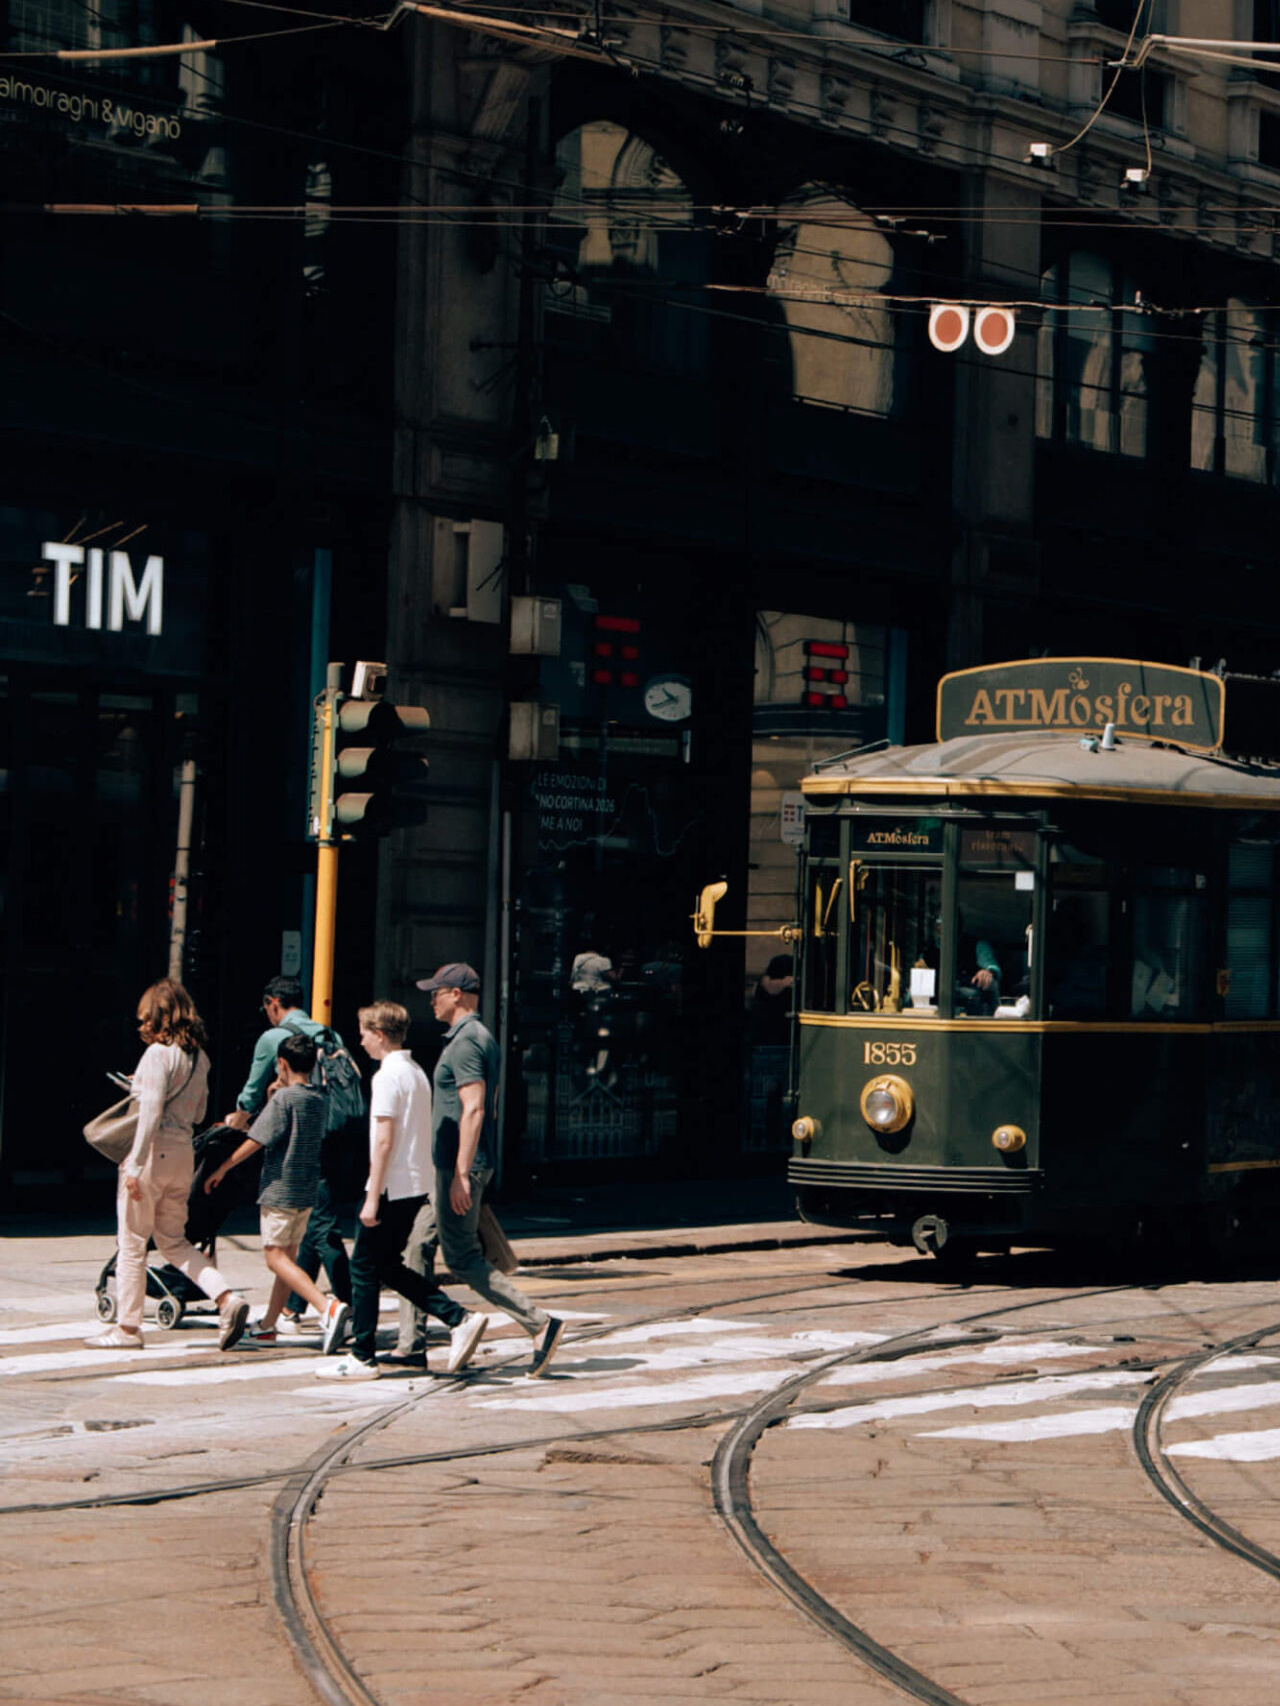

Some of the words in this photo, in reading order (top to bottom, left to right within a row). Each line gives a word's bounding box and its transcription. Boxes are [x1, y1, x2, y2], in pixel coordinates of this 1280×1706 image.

[0, 75, 99, 122] almoiraghi
[101, 98, 113, 124] &
[41, 541, 164, 636] TIM
[963, 681, 1195, 726] ATMosfera
[555, 795, 594, 811] CORTINA
[866, 830, 930, 846] ATMosfera
[863, 1041, 917, 1066] 1855
